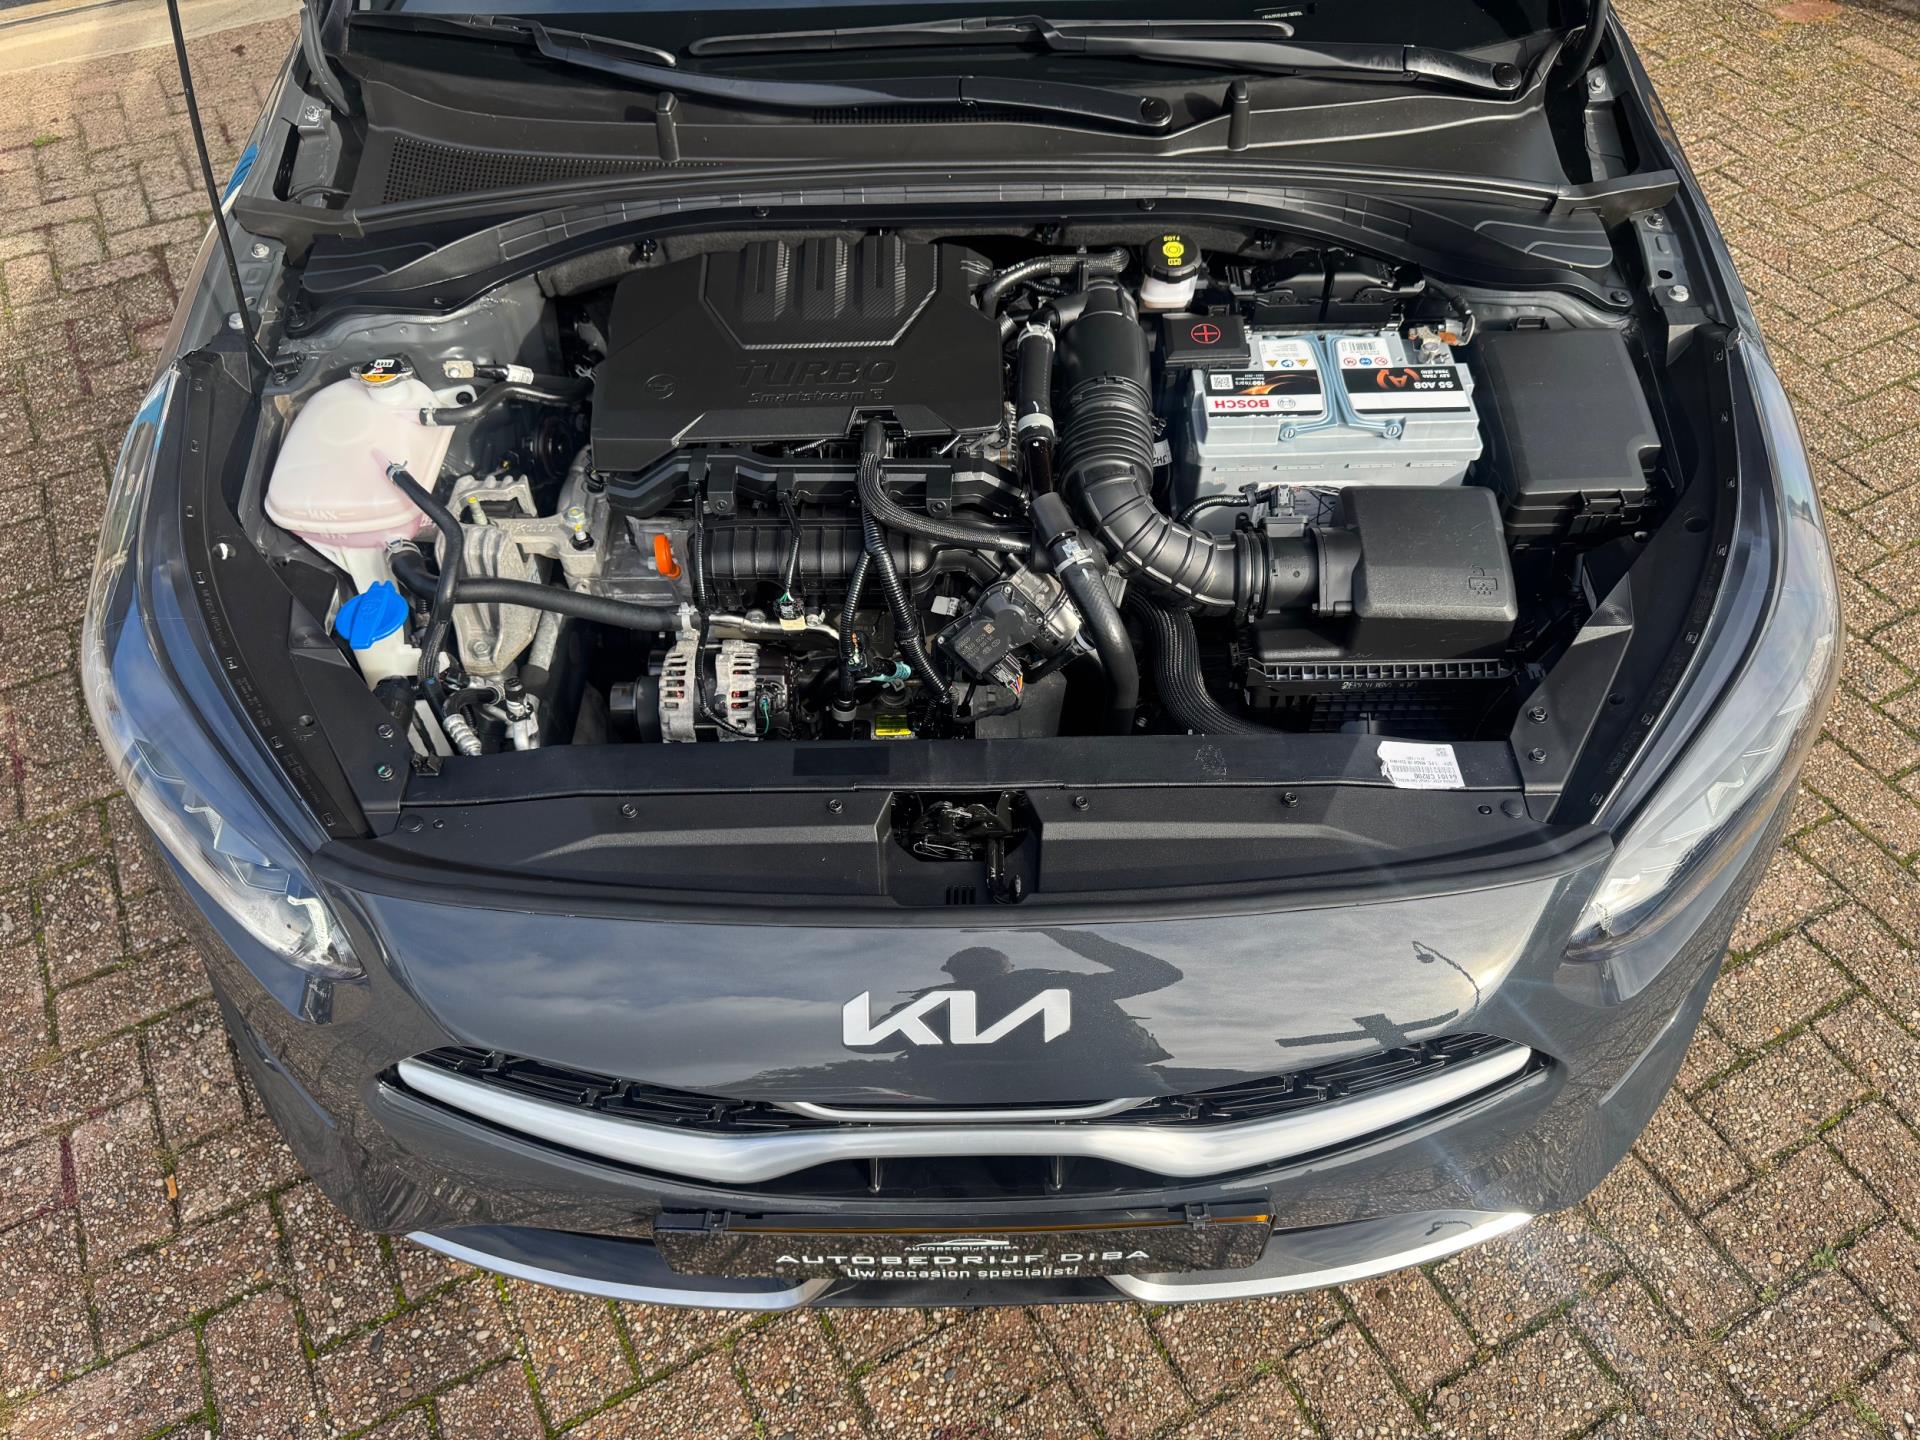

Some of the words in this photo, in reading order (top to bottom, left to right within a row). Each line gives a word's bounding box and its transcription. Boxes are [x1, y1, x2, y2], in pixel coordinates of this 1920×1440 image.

[736, 359, 898, 388] TURBO
[1414, 381, 1436, 389] A08
[1438, 380, 1454, 388] S5
[748, 391, 865, 403] Smartstream
[1214, 399, 1270, 409] BOSCH
[308, 510, 338, 520] MAX
[843, 988, 1071, 1046] KIA
[775, 1254, 1045, 1265] AUTOBEDRIJF
[1060, 1250, 1150, 1263] DIBA
[846, 1268, 876, 1278] Uw
[882, 1268, 970, 1278] occasion
